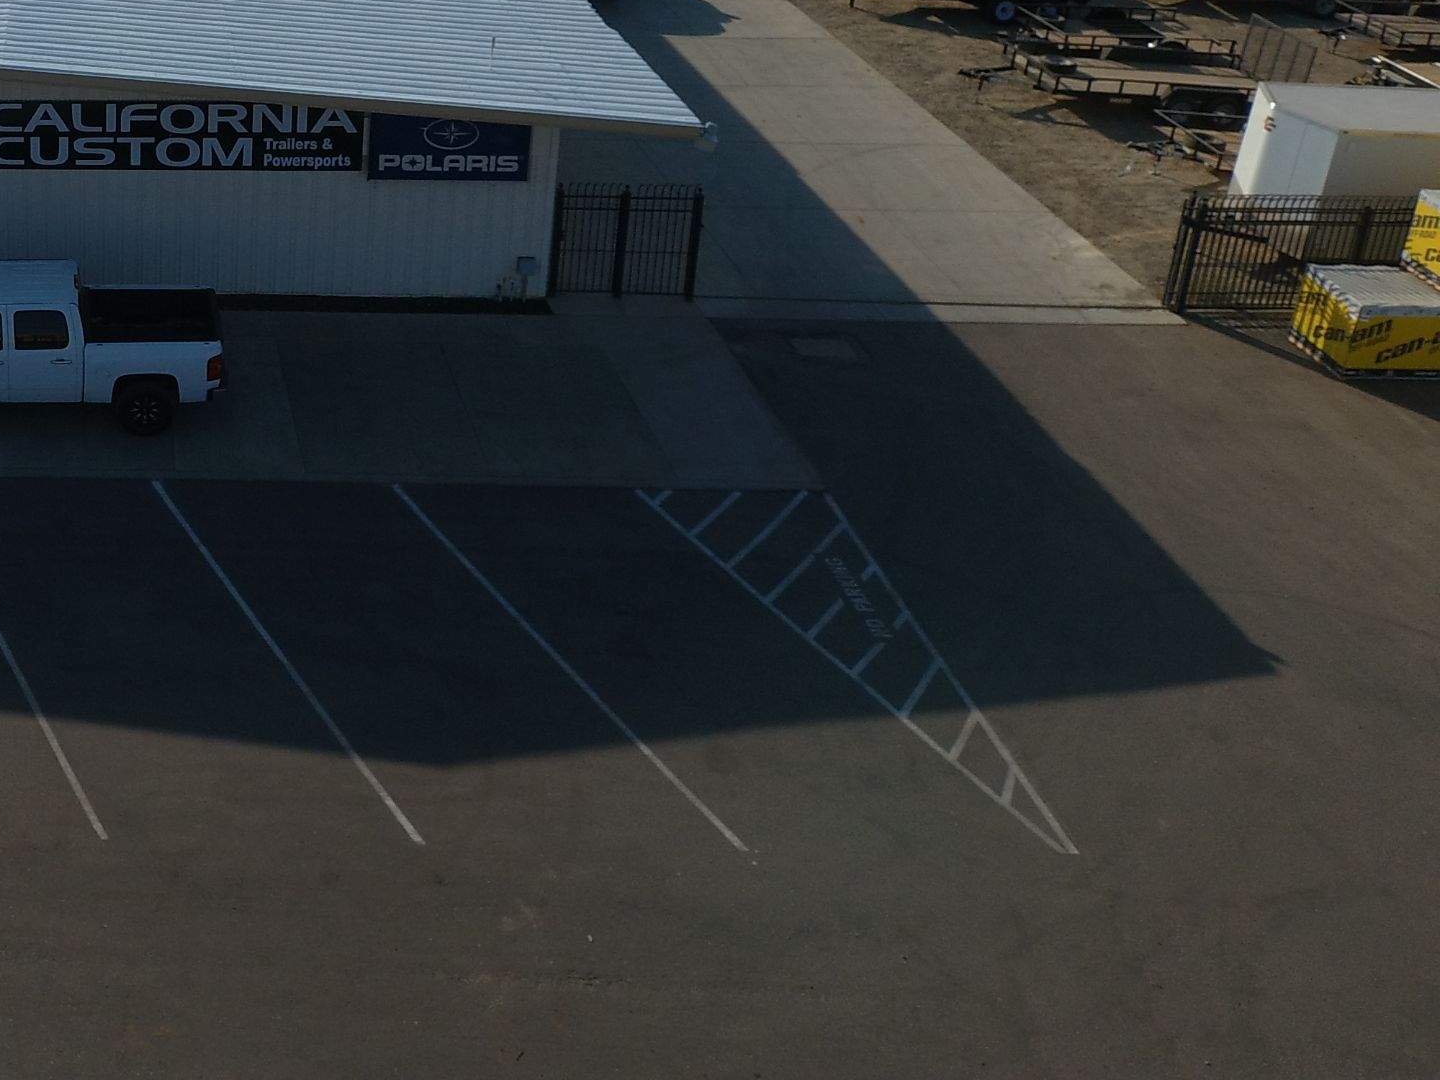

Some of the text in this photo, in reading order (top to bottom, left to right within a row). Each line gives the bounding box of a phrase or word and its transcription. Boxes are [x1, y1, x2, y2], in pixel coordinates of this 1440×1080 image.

[263, 137, 318, 151] Trailers
[322, 137, 334, 150] &
[263, 153, 352, 170] Powersports
[378, 154, 520, 172] POLARIS
